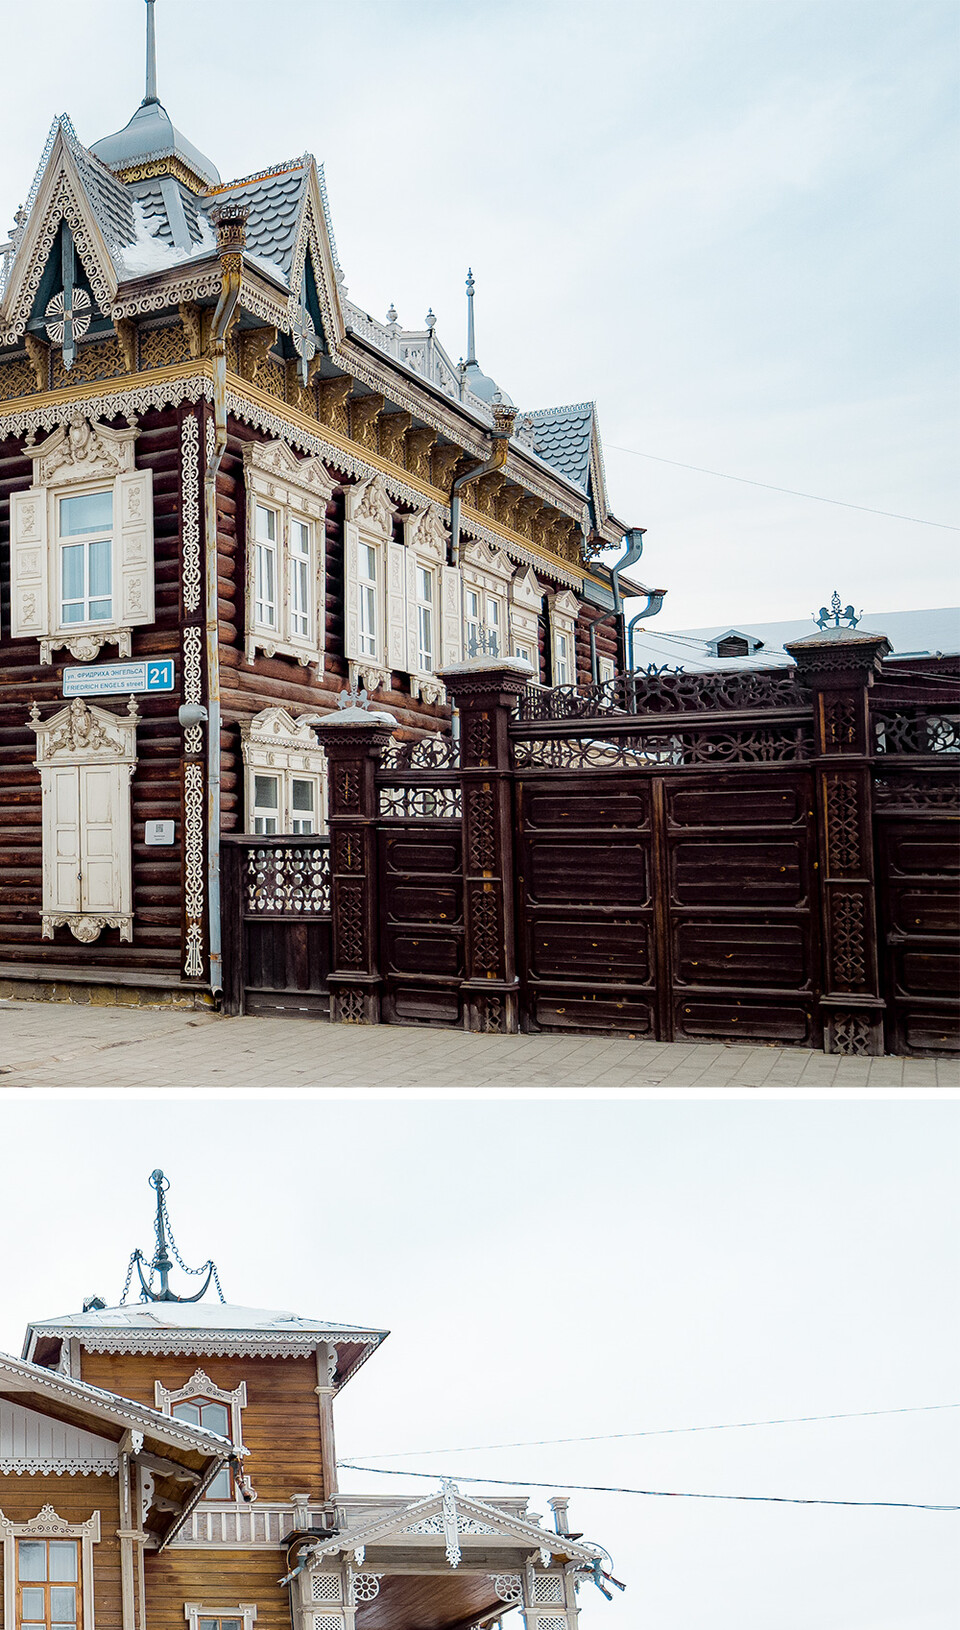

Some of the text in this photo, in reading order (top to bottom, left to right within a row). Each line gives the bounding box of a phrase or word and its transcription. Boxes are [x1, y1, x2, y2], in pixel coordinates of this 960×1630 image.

[77, 669, 109, 679] ФРИДРИХА
[111, 668, 143, 676] ЭНГЕЛЬСА
[149, 667, 168, 684] 21
[67, 683, 98, 691] FRIEDRICH
